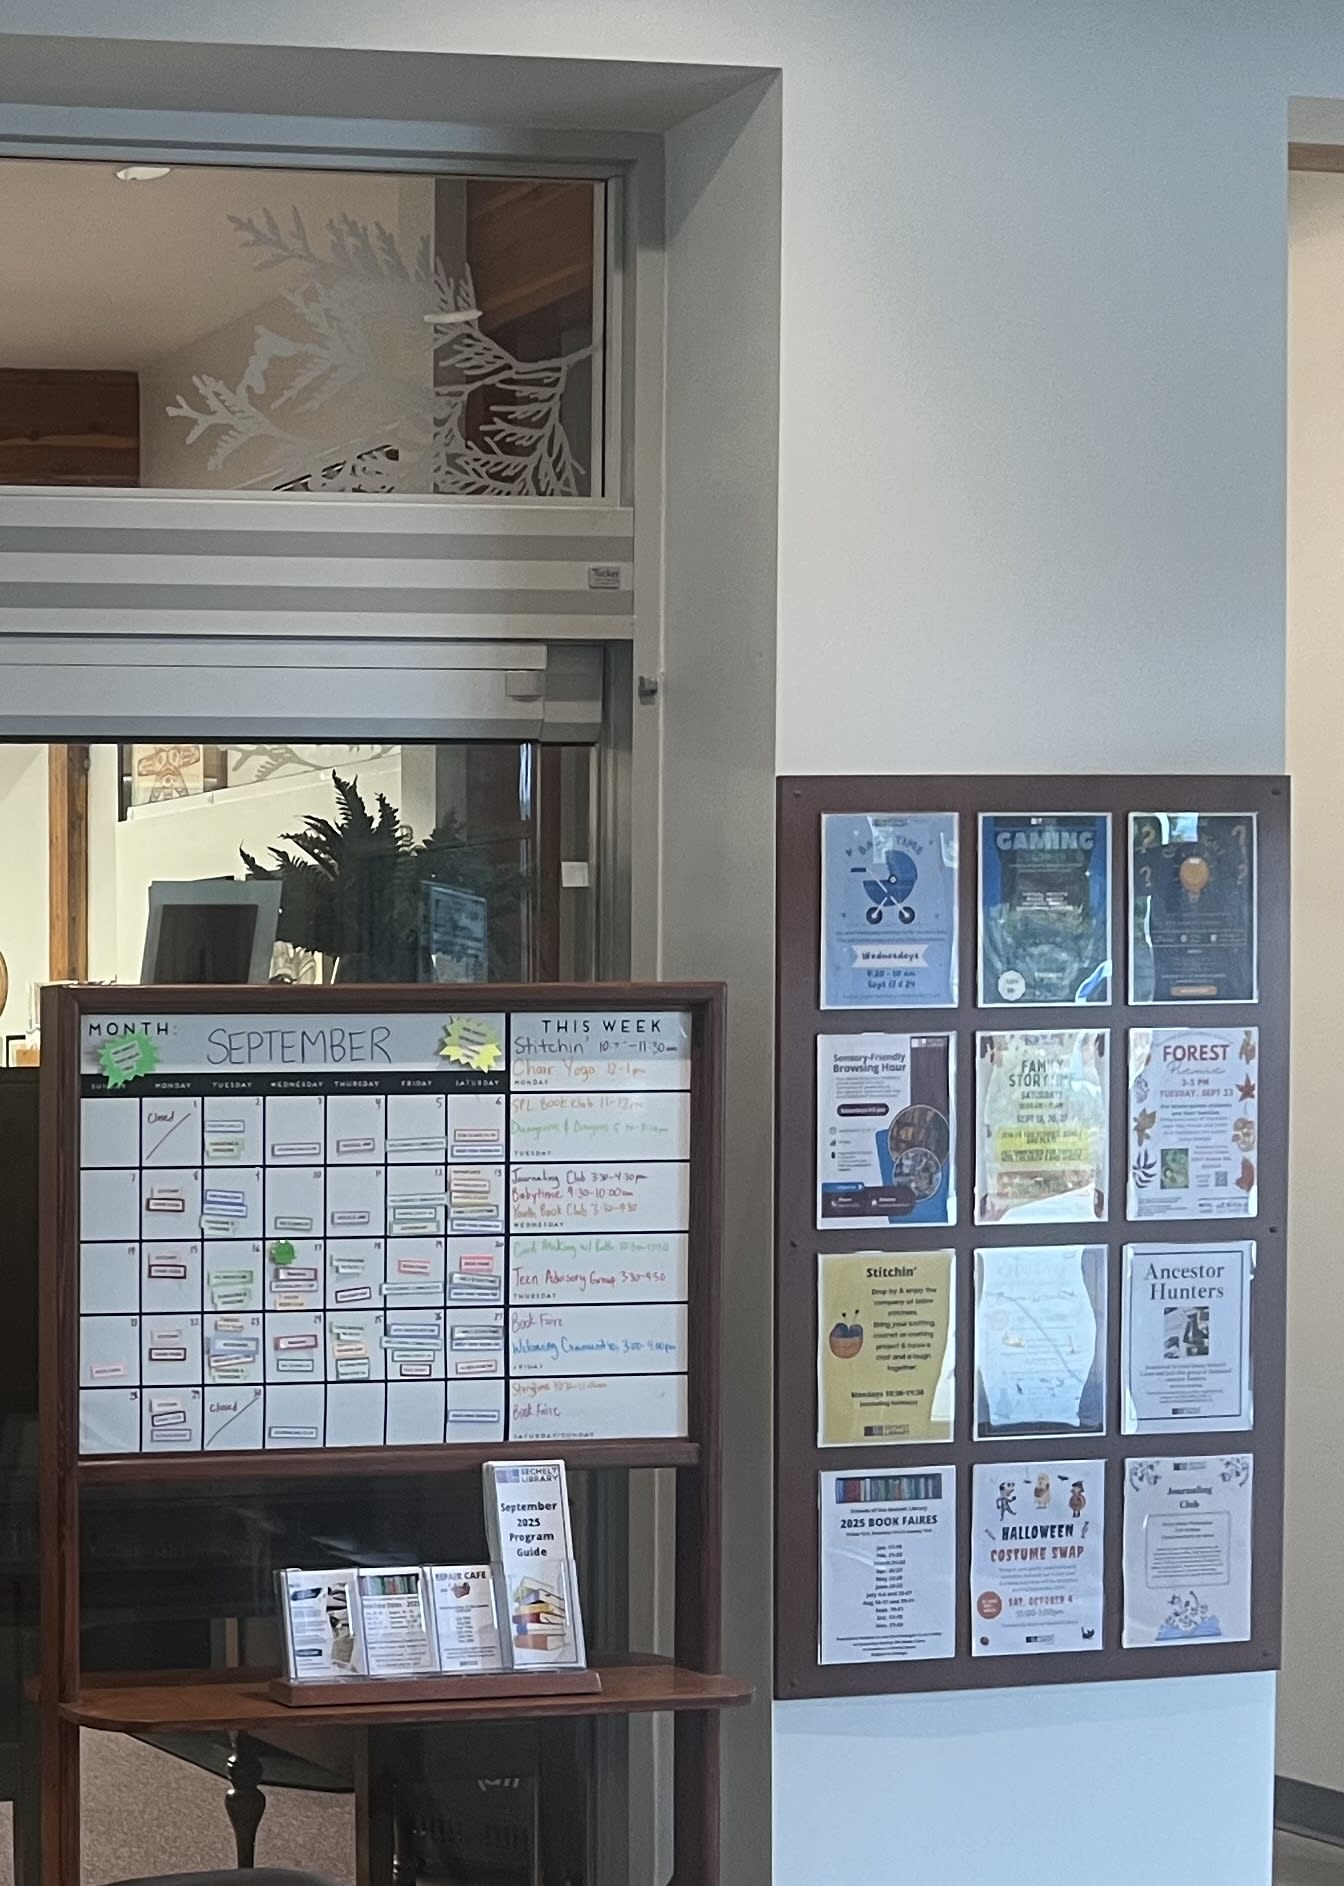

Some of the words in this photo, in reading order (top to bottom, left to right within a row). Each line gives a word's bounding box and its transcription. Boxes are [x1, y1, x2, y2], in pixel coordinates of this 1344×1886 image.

[996, 831, 1094, 850] GAMING
[541, 1020, 590, 1033] THIS
[603, 1019, 661, 1033] WEEK
[207, 1026, 392, 1064] SEPTEMBER
[514, 1036, 590, 1055] Stitchin'
[833, 1053, 906, 1065] Sensory-Friendly
[1163, 1044, 1230, 1062] FOREST
[513, 1058, 556, 1077] Chair
[563, 1059, 596, 1082] Yoga
[833, 1063, 879, 1074] Browsing
[881, 1062, 906, 1072] Hour
[213, 1081, 252, 1089] TUESDAY
[334, 1080, 380, 1088] THURSDAY
[455, 1079, 500, 1087] SATURDAY
[436, 1098, 443, 1109] 5
[147, 1111, 175, 1124] Closed
[512, 1168, 560, 1189] Journaling
[566, 1169, 586, 1184] Club
[512, 1187, 561, 1201] Babytime
[866, 1266, 917, 1278] Stitchin'
[1144, 1263, 1226, 1281] Ancestor
[512, 1267, 538, 1286] Teen
[545, 1269, 587, 1292] Advisory
[1150, 1282, 1225, 1301] Hunters
[512, 1313, 535, 1332] Book
[209, 1401, 238, 1412] Closed
[521, 1467, 559, 1475] SECHELT
[1167, 1485, 1213, 1496] Journaling
[501, 1502, 558, 1514] September
[1179, 1499, 1200, 1509] Club
[517, 1518, 541, 1527] 2025
[840, 1519, 865, 1529] 2025
[868, 1516, 899, 1527] BOOK
[902, 1514, 938, 1525] FAIRES
[509, 1533, 555, 1544] Program
[1001, 1523, 1074, 1541] HALLOWEEN
[517, 1547, 547, 1556] Guide
[990, 1547, 1047, 1562] COSTUME
[1052, 1545, 1085, 1559] SWAP
[464, 1571, 487, 1579] CAFE
[1029, 1596, 1062, 1606] OCTOBER
[1068, 1595, 1073, 1604] 4
